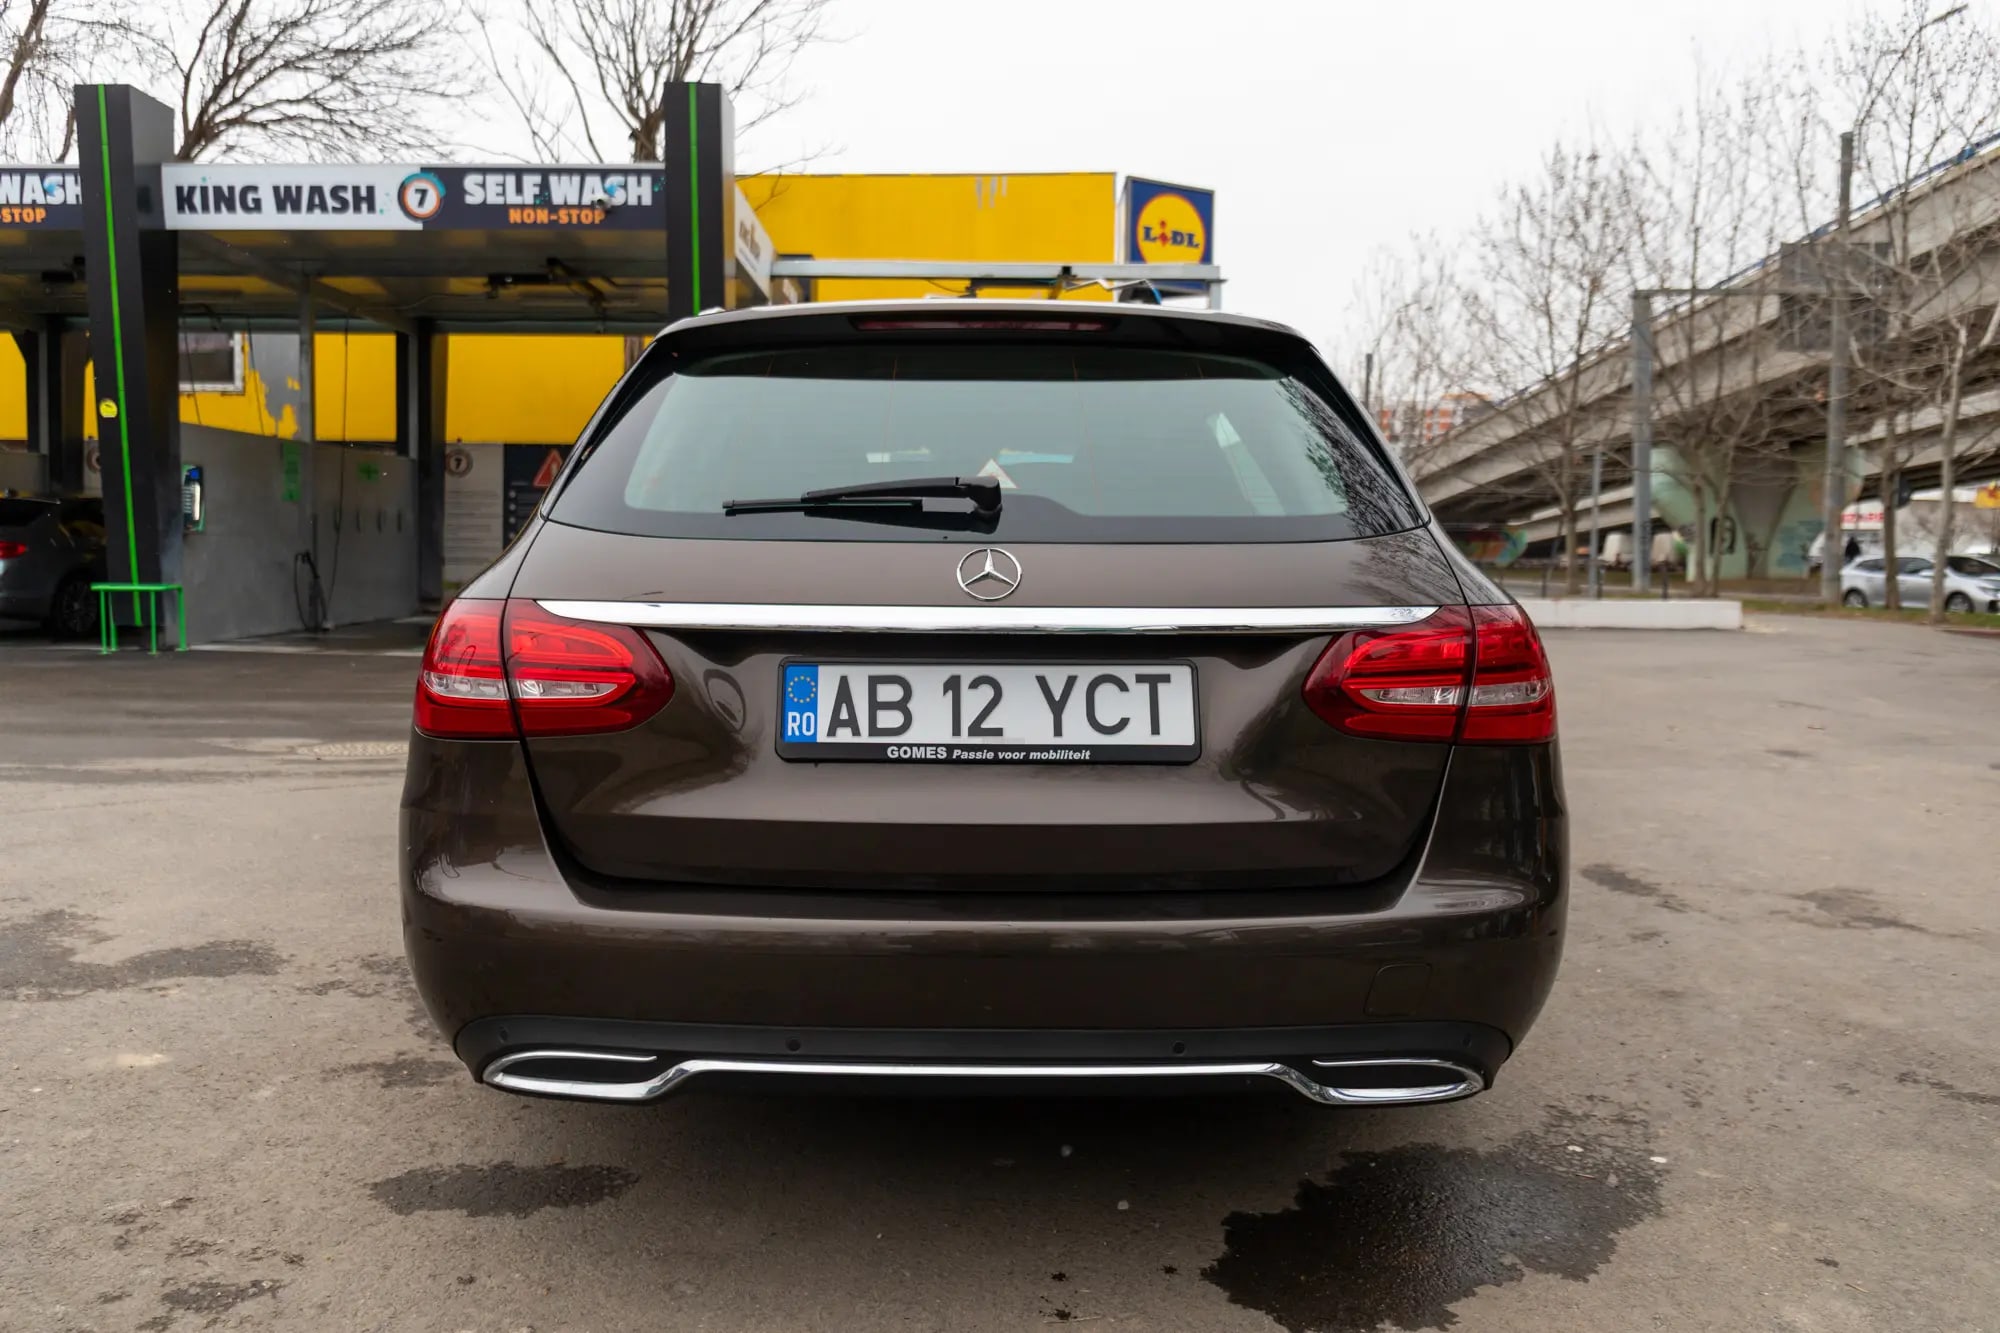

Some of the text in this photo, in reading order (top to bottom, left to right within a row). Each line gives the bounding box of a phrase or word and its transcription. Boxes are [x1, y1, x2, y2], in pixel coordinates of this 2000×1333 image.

[175, 185, 376, 215] KING WASH
[414, 188, 429, 209] 7
[463, 173, 653, 206] SELF WASH
[508, 208, 606, 225] NON-STOP
[826, 673, 1171, 738] AB 12 YCT
[787, 711, 815, 737] RO
[886, 746, 1091, 761] GOMES Passie voor mobiliteit
